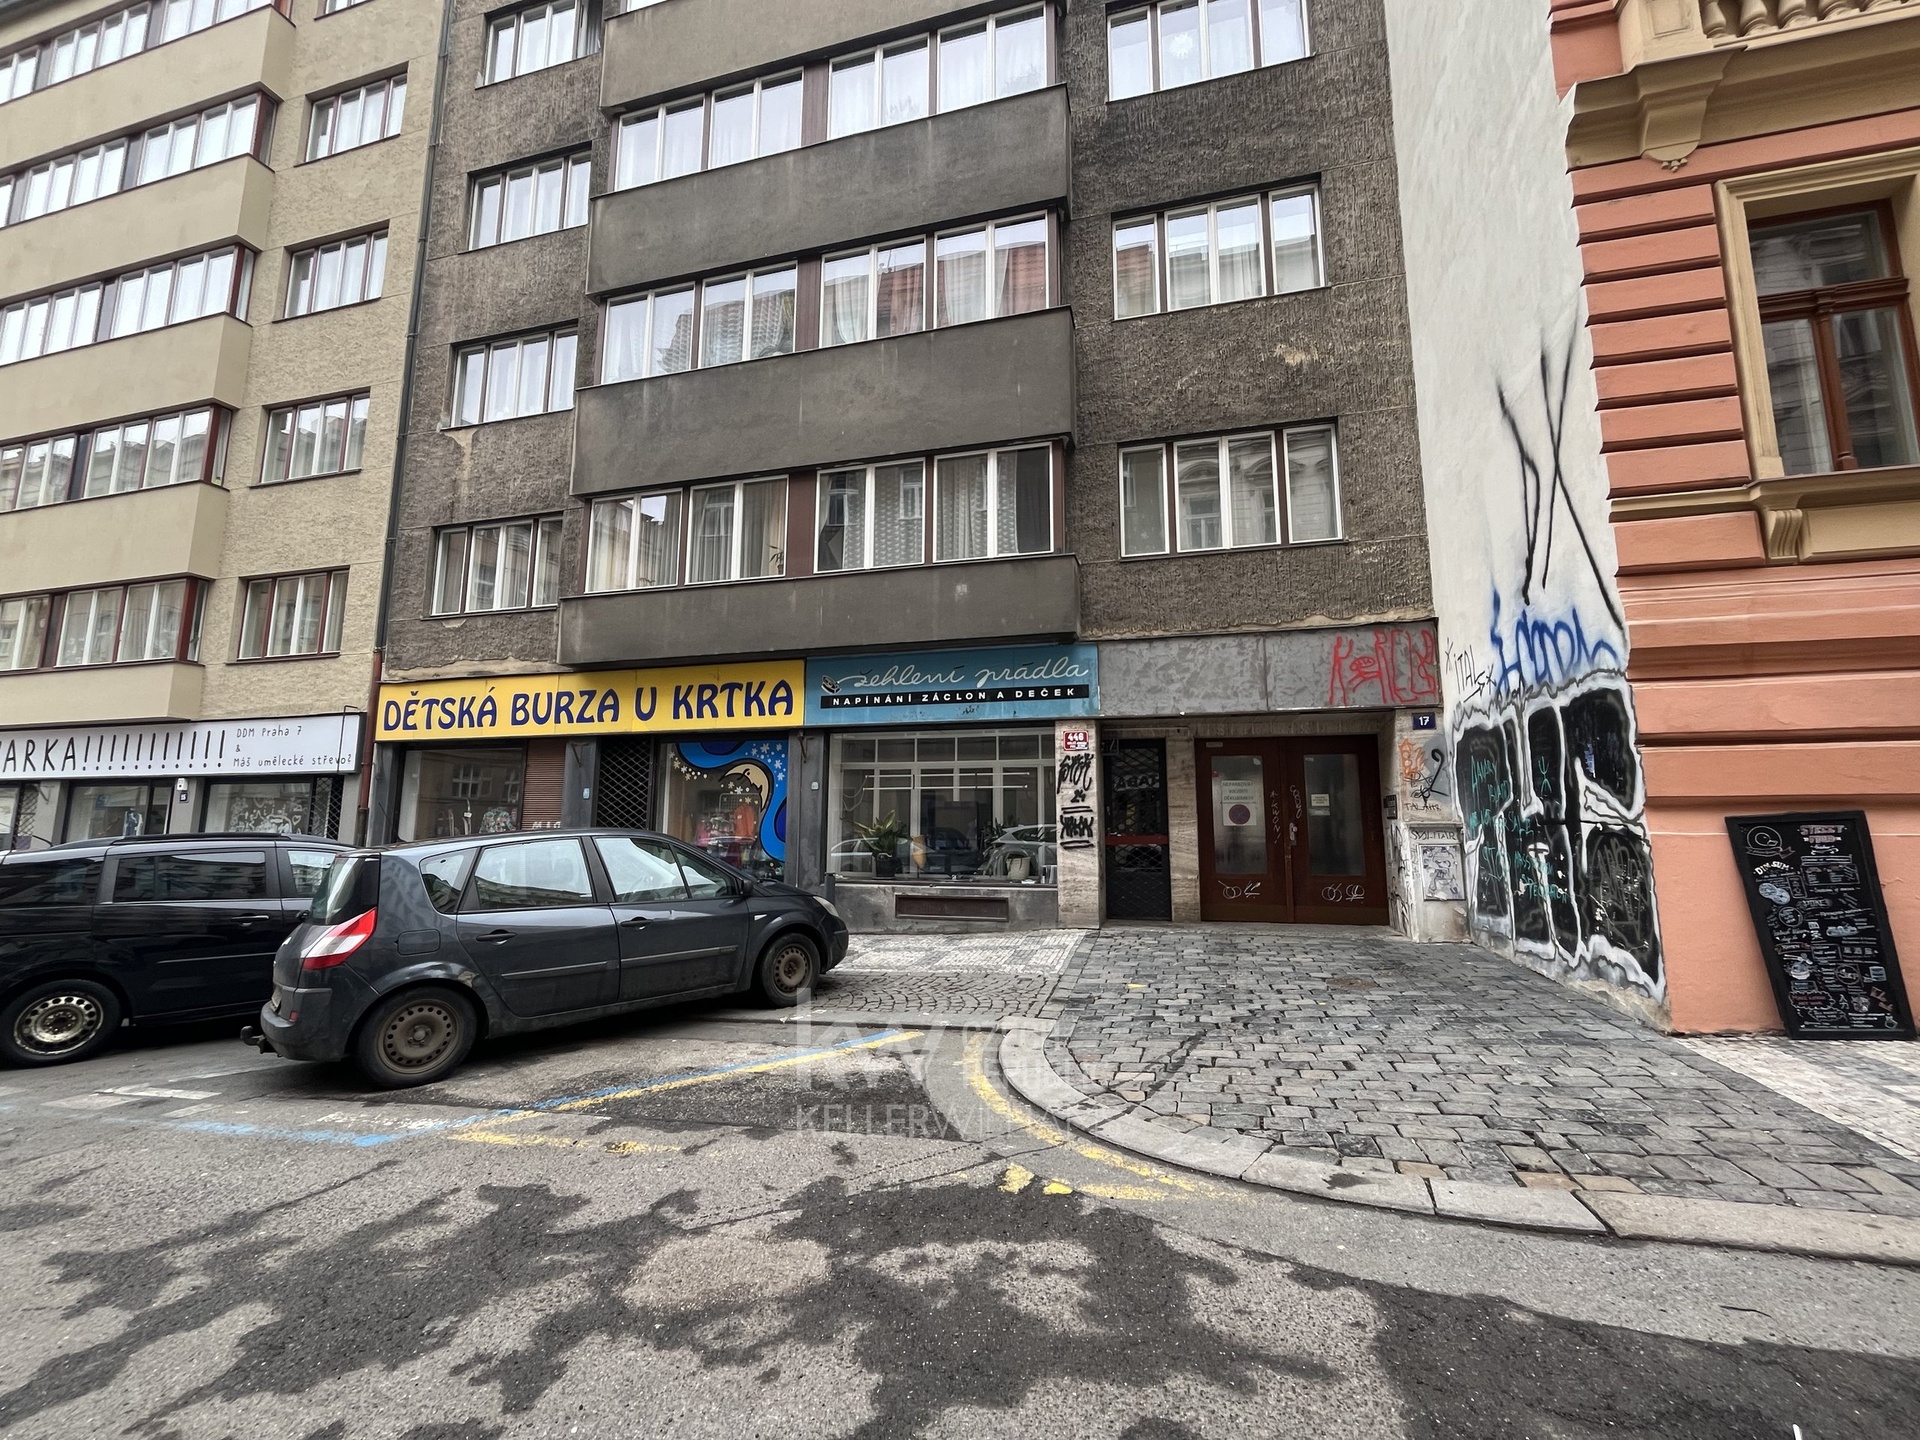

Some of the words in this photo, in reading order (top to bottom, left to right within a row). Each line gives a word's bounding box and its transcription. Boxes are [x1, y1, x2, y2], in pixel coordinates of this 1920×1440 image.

[848, 664, 965, 688] žehlení
[974, 656, 1089, 688] prádla
[832, 692, 913, 706] NAPÍNÁNÍ
[921, 690, 987, 702] ZÁCLON
[996, 691, 1004, 699] A
[1015, 687, 1075, 699] DEČEK
[383, 686, 498, 732] DĚTSKÁ
[511, 688, 620, 727] BURZA
[634, 685, 658, 722] U
[672, 679, 794, 721] KRTKA
[1419, 716, 1430, 726] 17
[236, 728, 255, 738] DDM
[261, 725, 290, 737] Praha
[297, 725, 302, 736] 7
[0, 729, 226, 773] ARKA!!!!!!!!!!!
[235, 744, 241, 753] &
[233, 757, 251, 767] Máš
[258, 754, 304, 767] umělecké
[311, 753, 352, 765] střevo?
